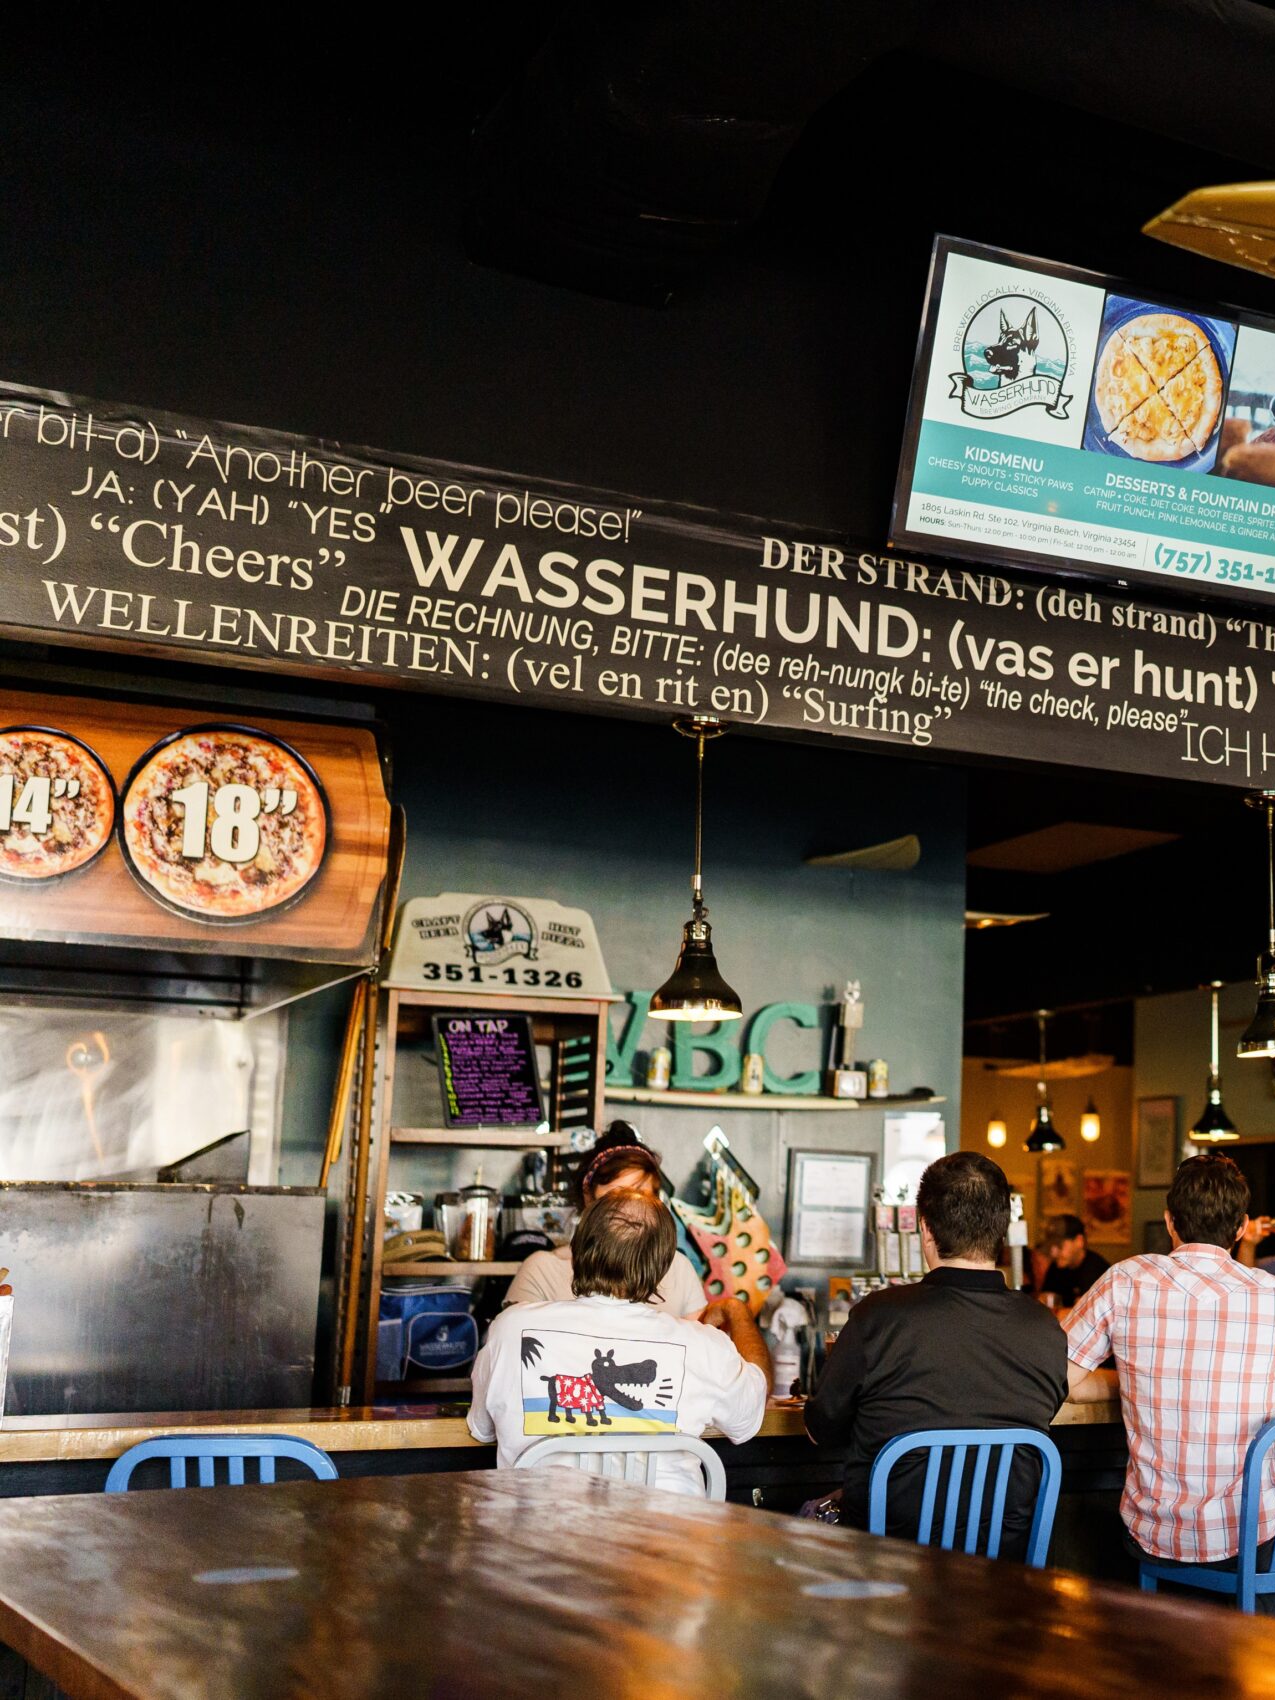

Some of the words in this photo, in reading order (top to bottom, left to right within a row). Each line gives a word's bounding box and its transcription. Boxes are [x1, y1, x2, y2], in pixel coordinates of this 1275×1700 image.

[953, 305, 976, 352] BREWED
[976, 285, 1020, 309] LOCALLY
[1028, 287, 1065, 321] VIRGINIA
[1067, 361, 1077, 377] VA
[966, 380, 1056, 408] WASSERHUND
[37, 404, 160, 465] bit-a)
[175, 428, 375, 498] “Another
[388, 466, 486, 517] beer
[495, 490, 643, 543] please!”
[928, 457, 966, 471] CHEESY
[967, 463, 1006, 479] SNOUTS
[1013, 473, 1046, 486] STICKY
[1047, 479, 1074, 492] PAWS
[964, 446, 1044, 472] KIDSMENU
[71, 466, 135, 505] JA:
[153, 478, 270, 526] (YAH)
[287, 500, 393, 542] “YES”
[961, 475, 993, 491] PUPPY
[994, 482, 1038, 498] CLASSICS
[1083, 486, 1116, 499] CATNIP
[1150, 498, 1170, 510] DIET
[1198, 507, 1221, 519] ROOT
[1105, 472, 1175, 498] DESSERTS
[1178, 487, 1187, 501] &
[1191, 490, 1259, 514] FOUNTAIN
[921, 502, 942, 514] 1805
[944, 505, 970, 519] Laskin
[988, 511, 1002, 524] Ste
[1021, 519, 1052, 533] Virginia
[1082, 530, 1112, 543] Virginia
[1113, 537, 1137, 548] 23454
[1096, 500, 1122, 513] FRUIT
[1158, 511, 1178, 524] PINK
[1230, 526, 1236, 534] &
[1237, 527, 1269, 540] GINGER
[90, 512, 346, 591] “Cheers”
[1154, 542, 1212, 574] (757)
[759, 535, 848, 582] DER
[856, 552, 1026, 612] STRAND:
[1035, 585, 1103, 624] (deh
[1111, 601, 1219, 650] strand)
[399, 525, 932, 664] WASSERHUND:
[947, 618, 1055, 682] (vas
[1067, 649, 1121, 691] er
[1134, 649, 1259, 715] hunt)
[41, 579, 491, 680] WELLENREITEN:
[506, 646, 585, 693] (vel
[597, 666, 644, 700] en
[655, 668, 700, 708] rit
[711, 679, 769, 725] en)
[782, 684, 953, 746] “Surfing”
[339, 585, 401, 623] DIE
[406, 595, 600, 657] RECHNUNG,
[610, 625, 705, 667] BITTE:
[712, 640, 771, 677] (dee
[778, 653, 905, 697] reh-nungk
[910, 672, 971, 711] bi-te)
[980, 678, 1022, 711] “the
[1028, 688, 1101, 728] check,
[1106, 700, 1190, 734] please”
[1180, 721, 1252, 778] ICH
[171, 782, 299, 864] 18”
[423, 962, 584, 989] 351-1326
[448, 1020, 473, 1033] ON
[475, 1019, 509, 1034] TAP
